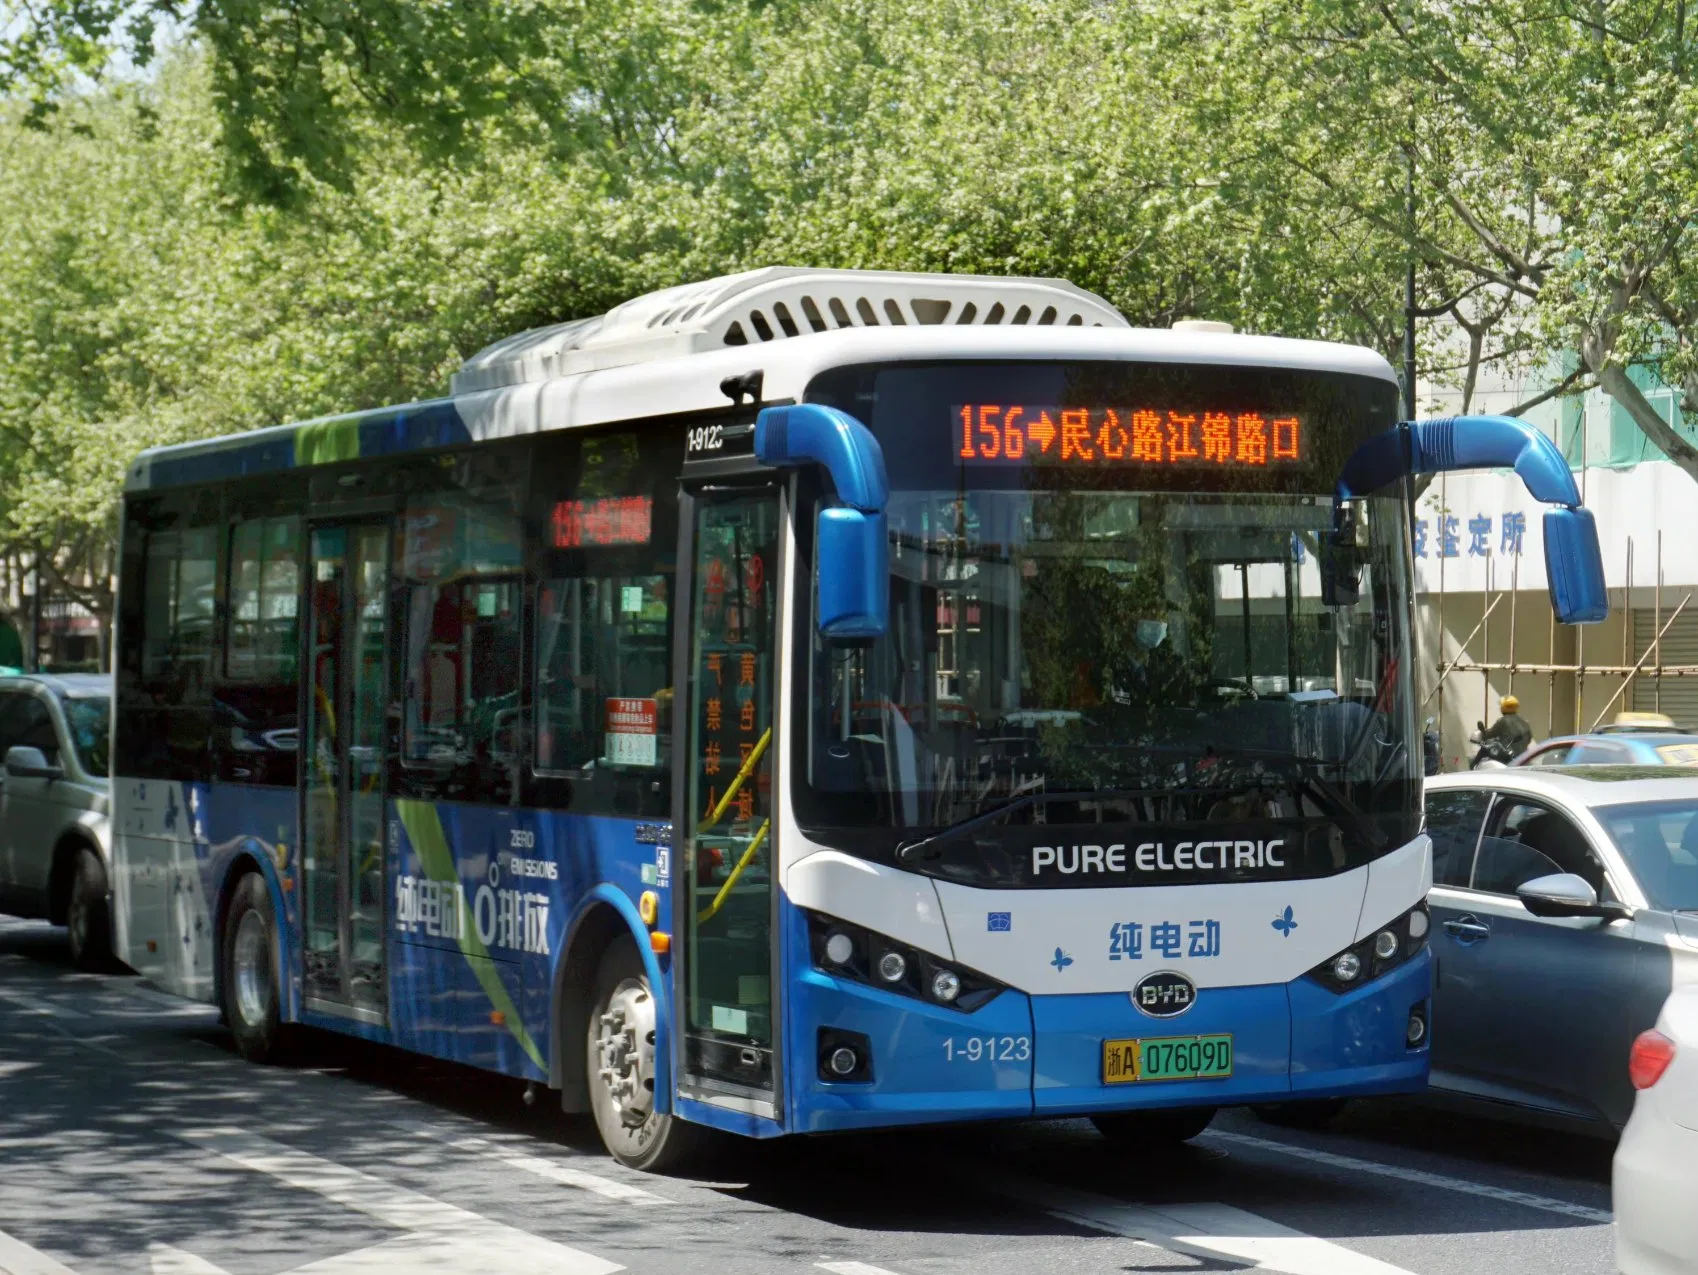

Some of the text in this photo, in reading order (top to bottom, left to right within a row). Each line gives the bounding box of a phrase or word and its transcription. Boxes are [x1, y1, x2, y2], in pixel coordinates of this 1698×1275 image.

[960, 404, 1299, 464] 156 民心路江锦路口
[1032, 839, 1285, 875] PURE ELECTRIC
[1108, 919, 1221, 961] 纯电动
[1142, 984, 1189, 1005] BYD
[942, 1036, 1031, 1061] 1-9123
[1146, 1040, 1230, 1075] 07609D
